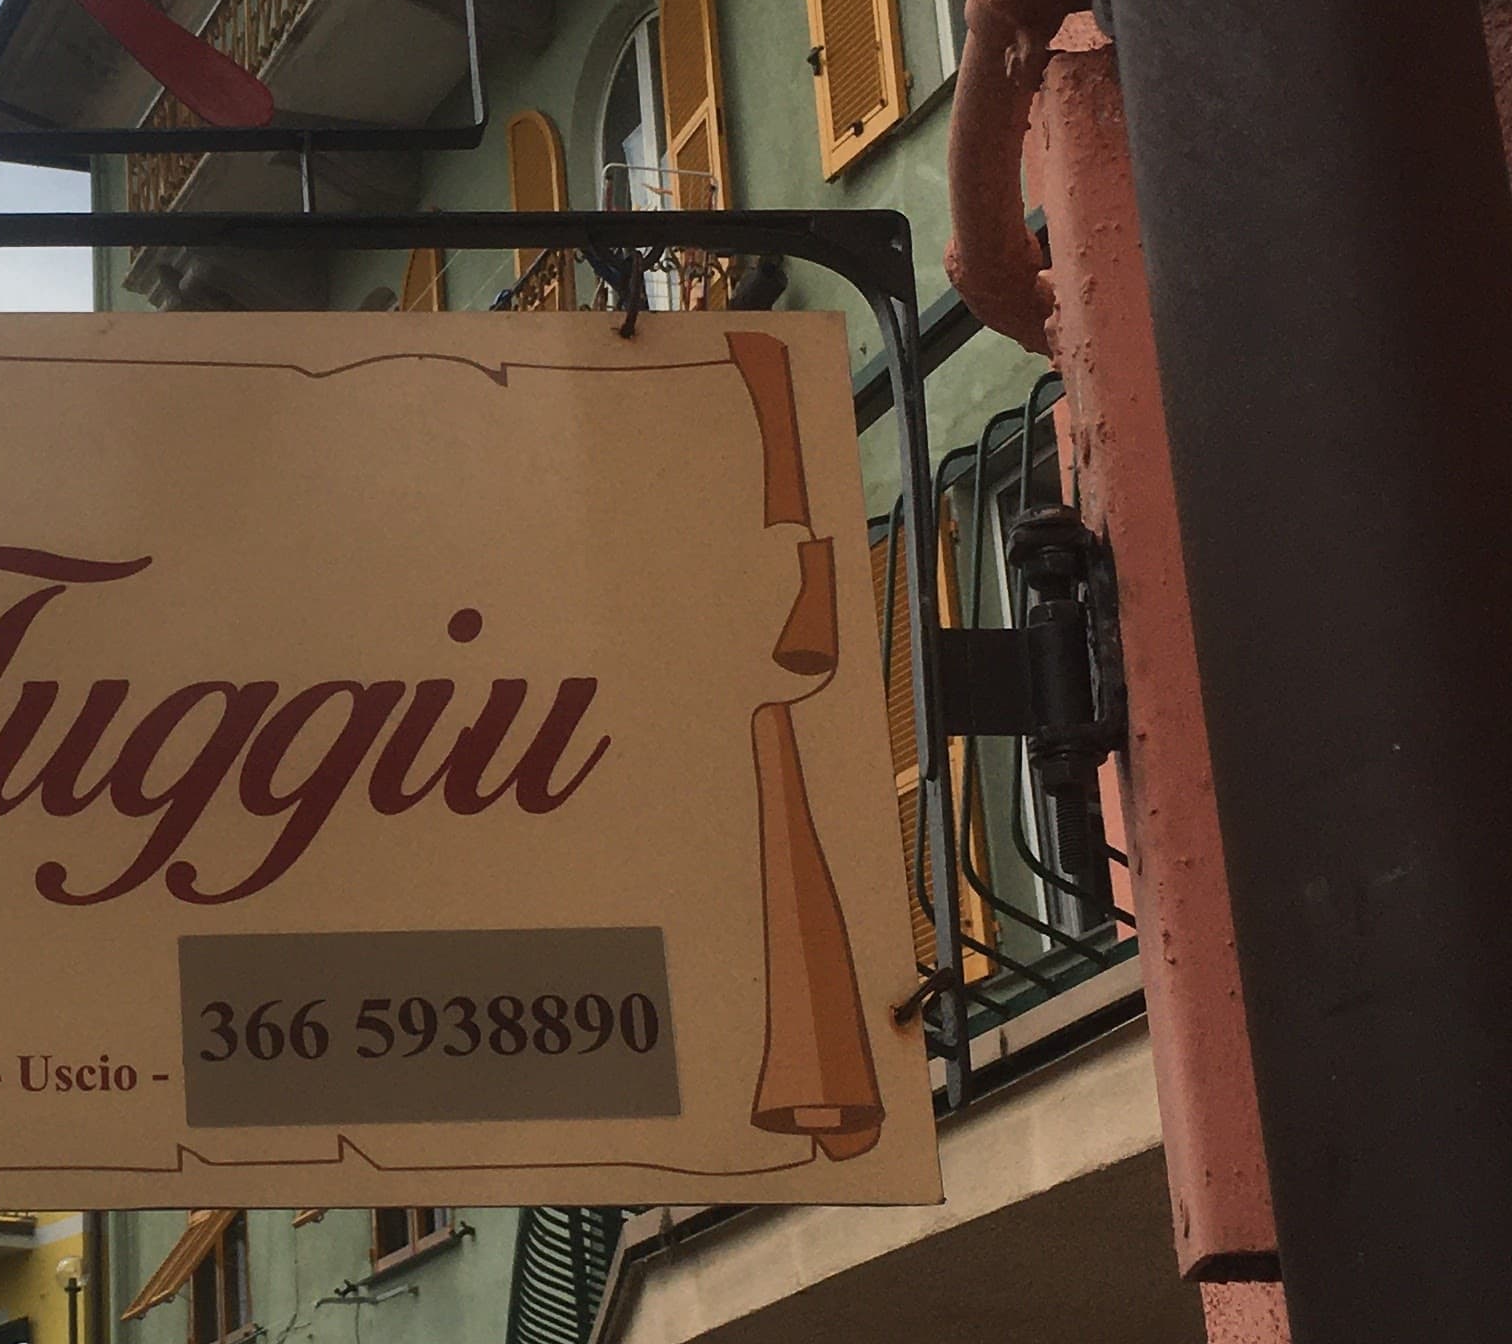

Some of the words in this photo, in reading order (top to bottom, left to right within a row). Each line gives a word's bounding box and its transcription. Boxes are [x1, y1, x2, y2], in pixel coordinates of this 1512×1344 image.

[199, 999, 330, 1063] 366
[355, 992, 660, 1058] 5938890
[17, 1054, 138, 1093] Uscio
